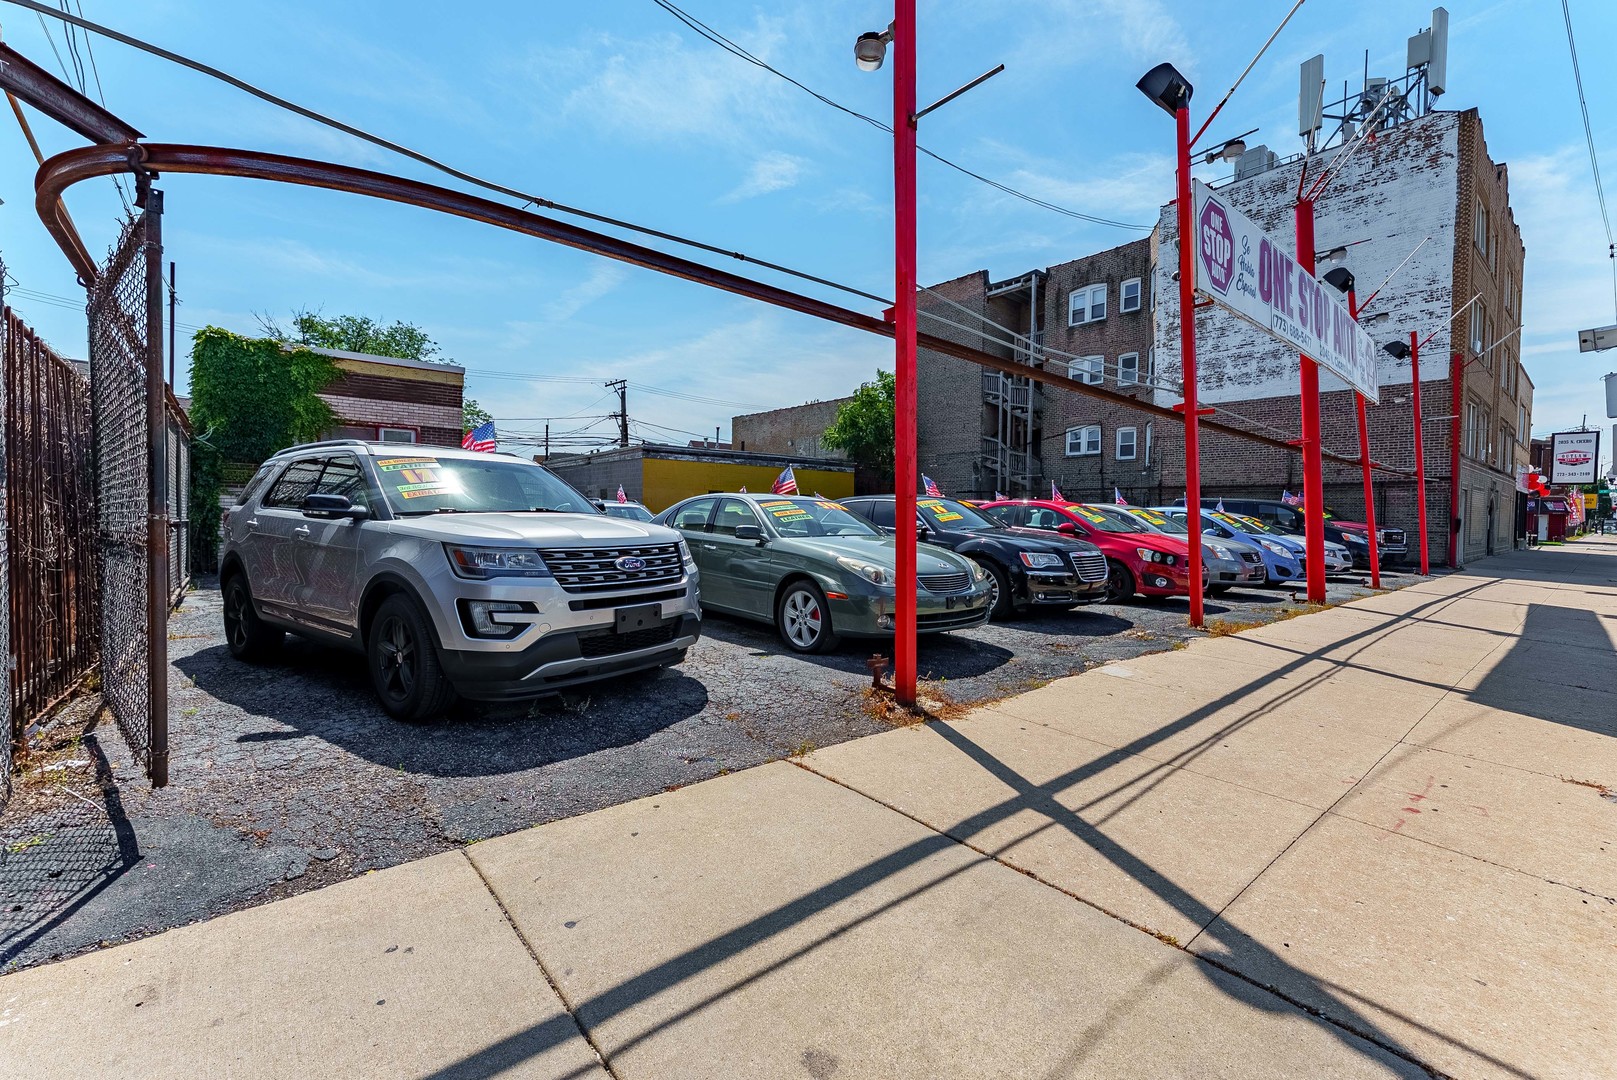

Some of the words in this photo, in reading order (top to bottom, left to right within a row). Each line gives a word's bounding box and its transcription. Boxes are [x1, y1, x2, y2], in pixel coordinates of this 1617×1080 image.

[1210, 211, 1223, 234] ONE
[1203, 224, 1231, 268] STOP
[1241, 235, 1250, 255] Se
[1211, 260, 1226, 284] AUTO
[1237, 254, 1256, 278] Habla
[1258, 236, 1294, 320] ONE
[1298, 270, 1331, 347] STOP
[1333, 302, 1358, 368] AUTO
[1272, 313, 1289, 335] (773)
[624, 559, 641, 568] Ford
